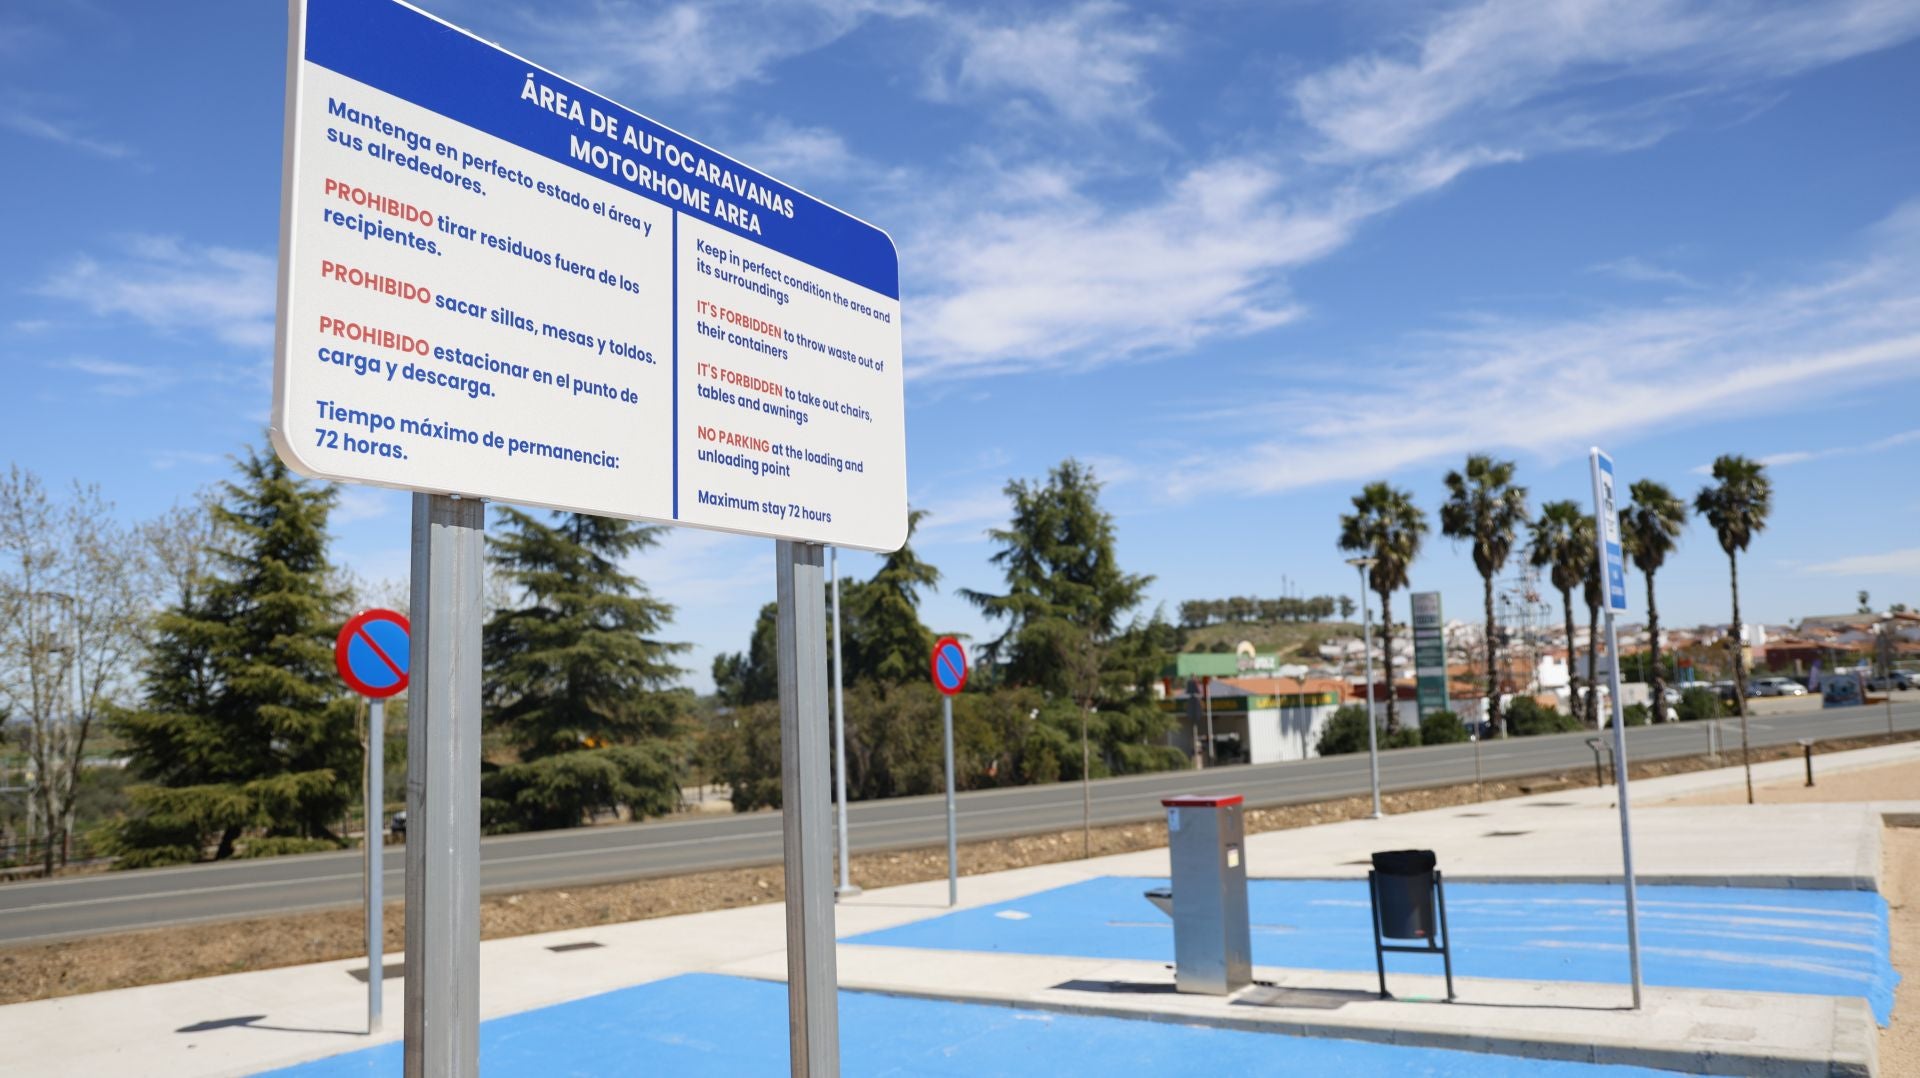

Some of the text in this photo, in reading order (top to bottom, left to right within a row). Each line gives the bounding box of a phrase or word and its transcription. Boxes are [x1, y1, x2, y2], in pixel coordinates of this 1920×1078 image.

[327, 128, 486, 196] sus alrededores.
[328, 97, 652, 237] Mantenga en perfecto estado el área y
[521, 73, 794, 218] ÁREA DE AUTOCARAVANAS
[571, 136, 761, 234] MOTORHOME AREA
[324, 208, 441, 256] recipientes.
[325, 178, 639, 294] PROHIBIDO tirar residuos fuera de los
[322, 260, 656, 364] PROHIBIDO sacar sillas, mesas y toldos.
[697, 239, 890, 323] Keep in perfect condition the area and
[697, 257, 789, 305] its surroundings
[320, 316, 638, 404] PROHIBIDO estacionar en el punto de
[697, 300, 883, 372] IT'S FORBIDDEN to throw waste out of
[697, 321, 788, 360] their containers
[318, 348, 495, 398] carga y descarga.
[697, 384, 808, 425] tables and awnings
[698, 362, 872, 423] IT'S FORBIDDEN to take out chairs,
[316, 400, 619, 469] Tiempo máximo de permanencia:
[316, 428, 407, 460] 72 horas.
[698, 426, 863, 472] NO PARKING at the loading and
[698, 449, 790, 477] unloading point
[698, 490, 831, 523] Maximum stay 72 hours
